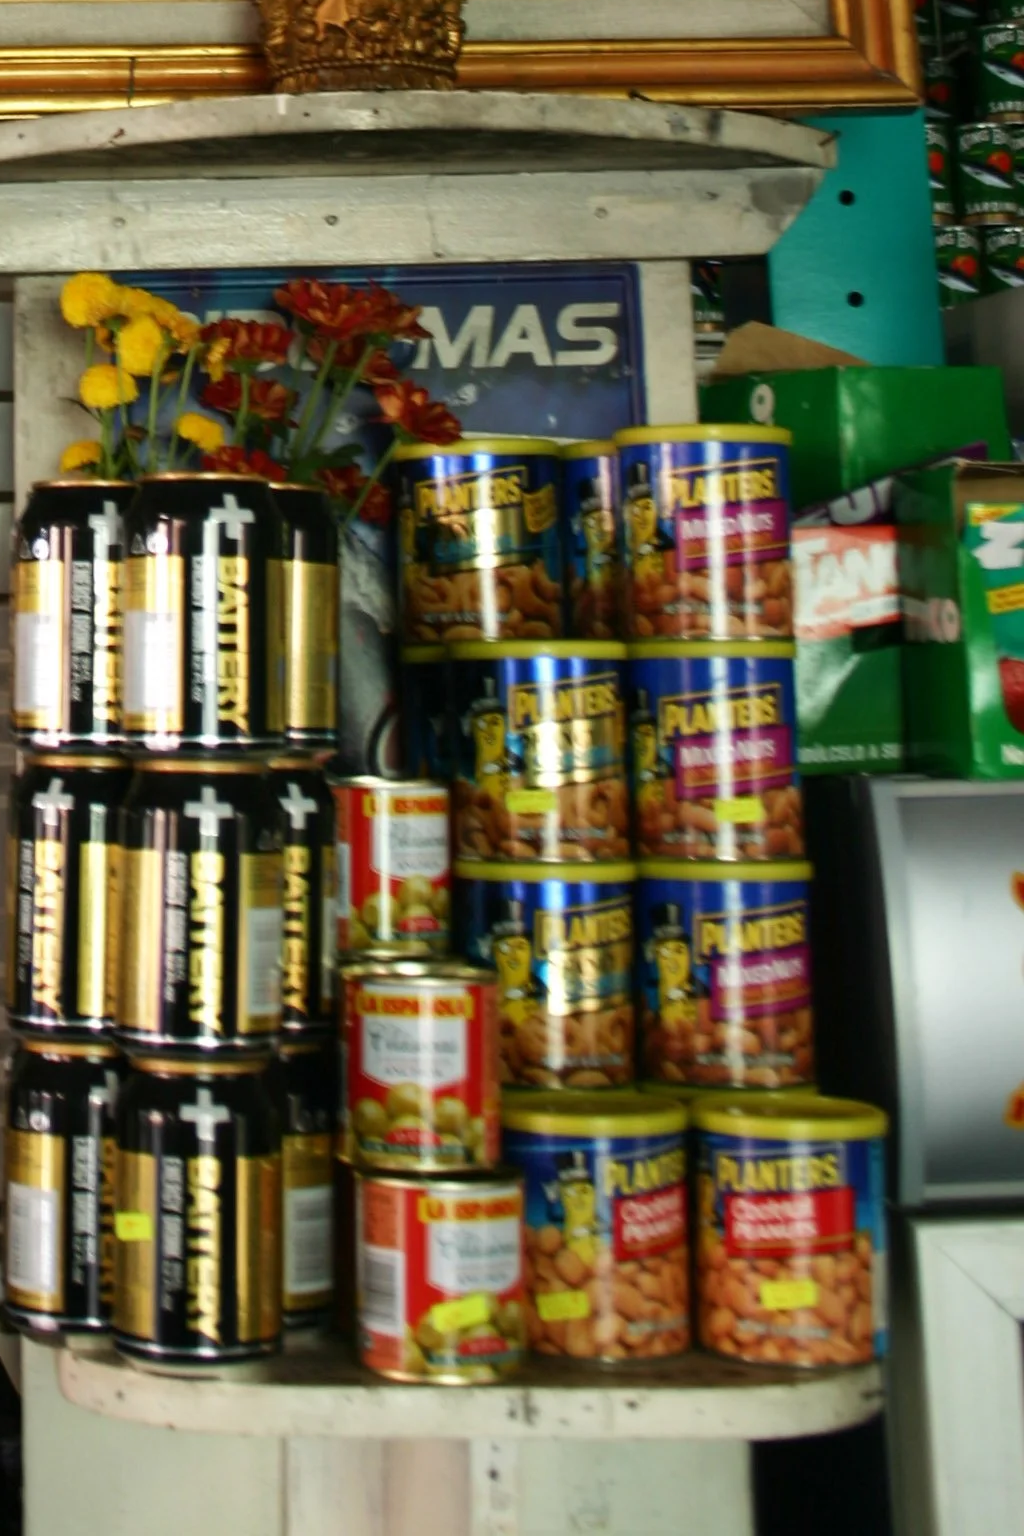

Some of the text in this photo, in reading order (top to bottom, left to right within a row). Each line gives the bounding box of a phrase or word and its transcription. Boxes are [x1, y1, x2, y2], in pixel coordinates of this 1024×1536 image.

[417, 474, 522, 519] PLANTRS
[217, 555, 250, 736] BATTERY
[189, 853, 225, 1034] BATTERY
[186, 1155, 223, 1344] BATTERY
[716, 1151, 839, 1192] PLANTERS
